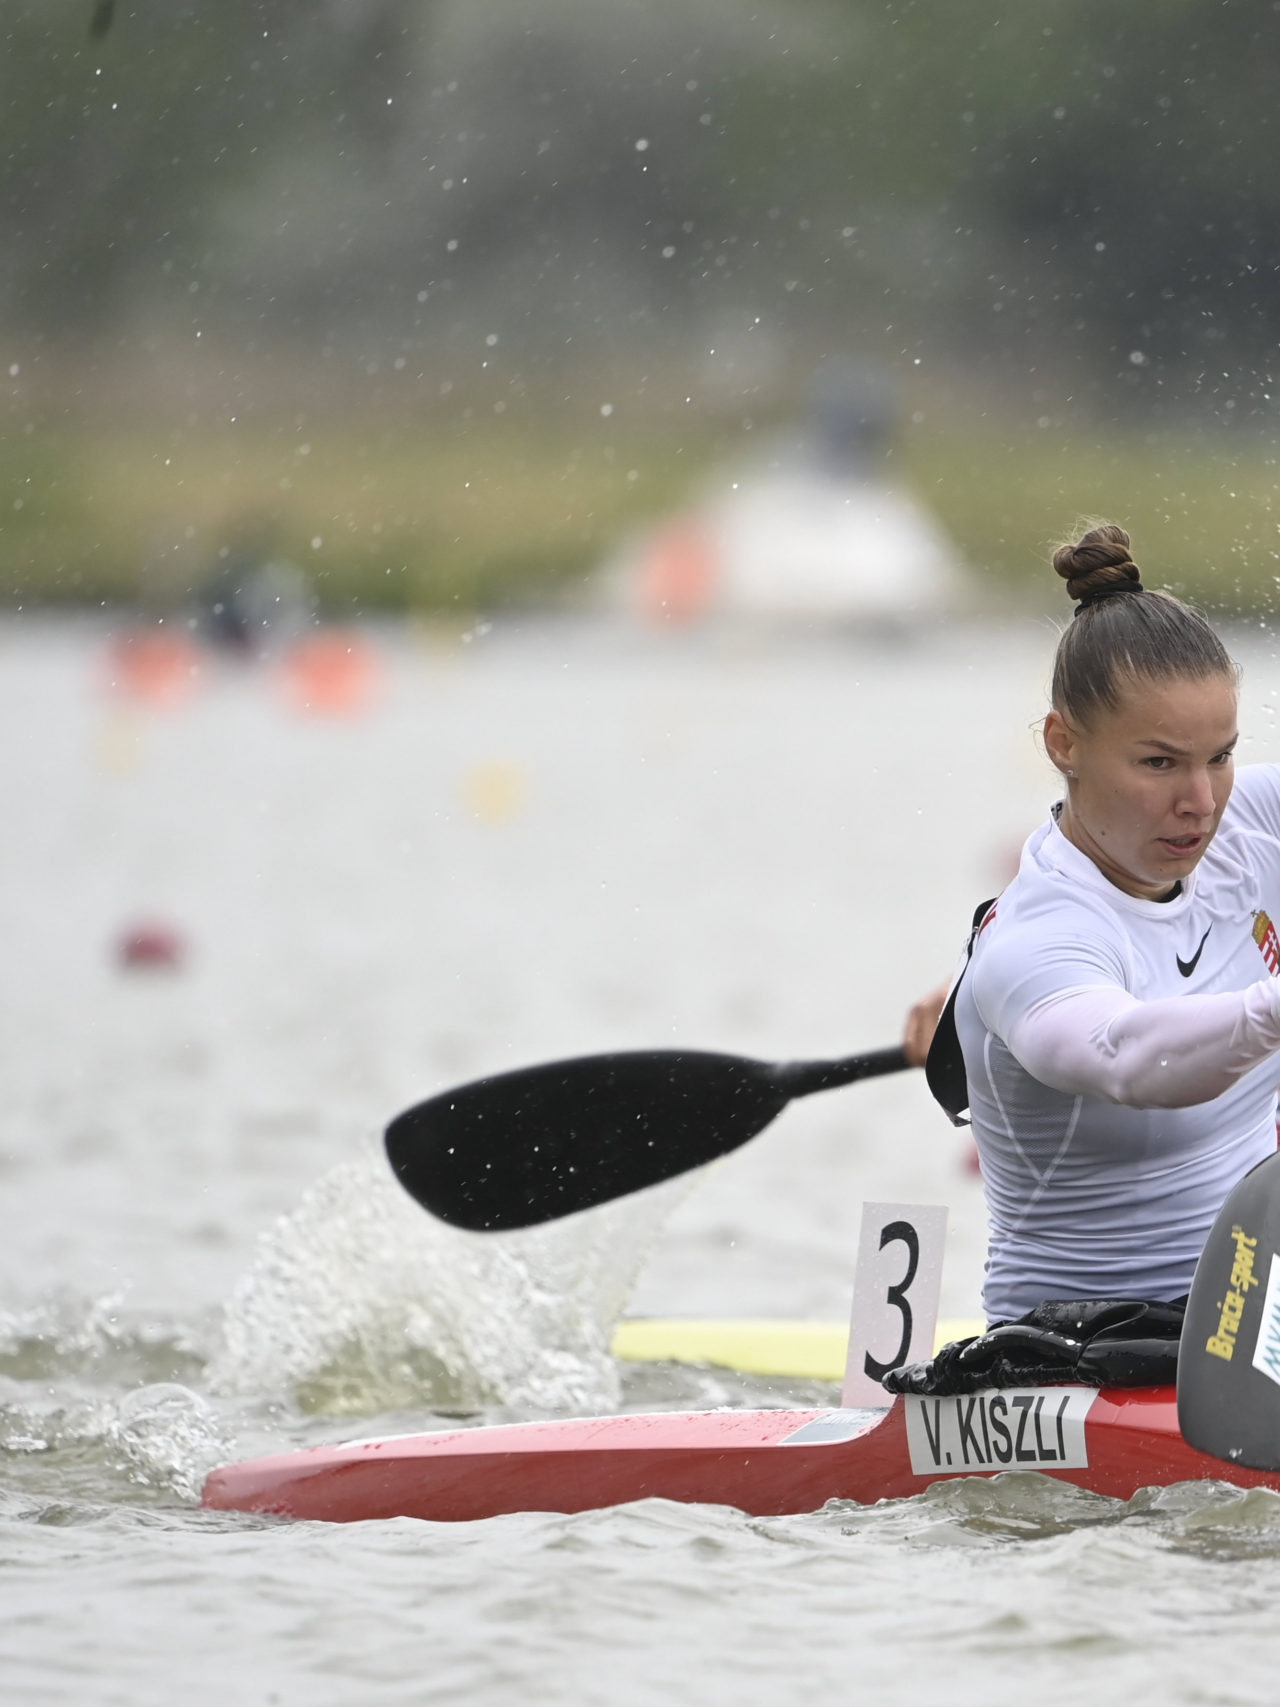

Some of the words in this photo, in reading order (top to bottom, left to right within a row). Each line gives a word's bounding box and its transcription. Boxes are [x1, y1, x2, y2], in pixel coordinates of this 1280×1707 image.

[864, 1221, 920, 1383] 3
[920, 1399, 953, 1466] V.
[956, 1395, 1071, 1464] KISZLI
